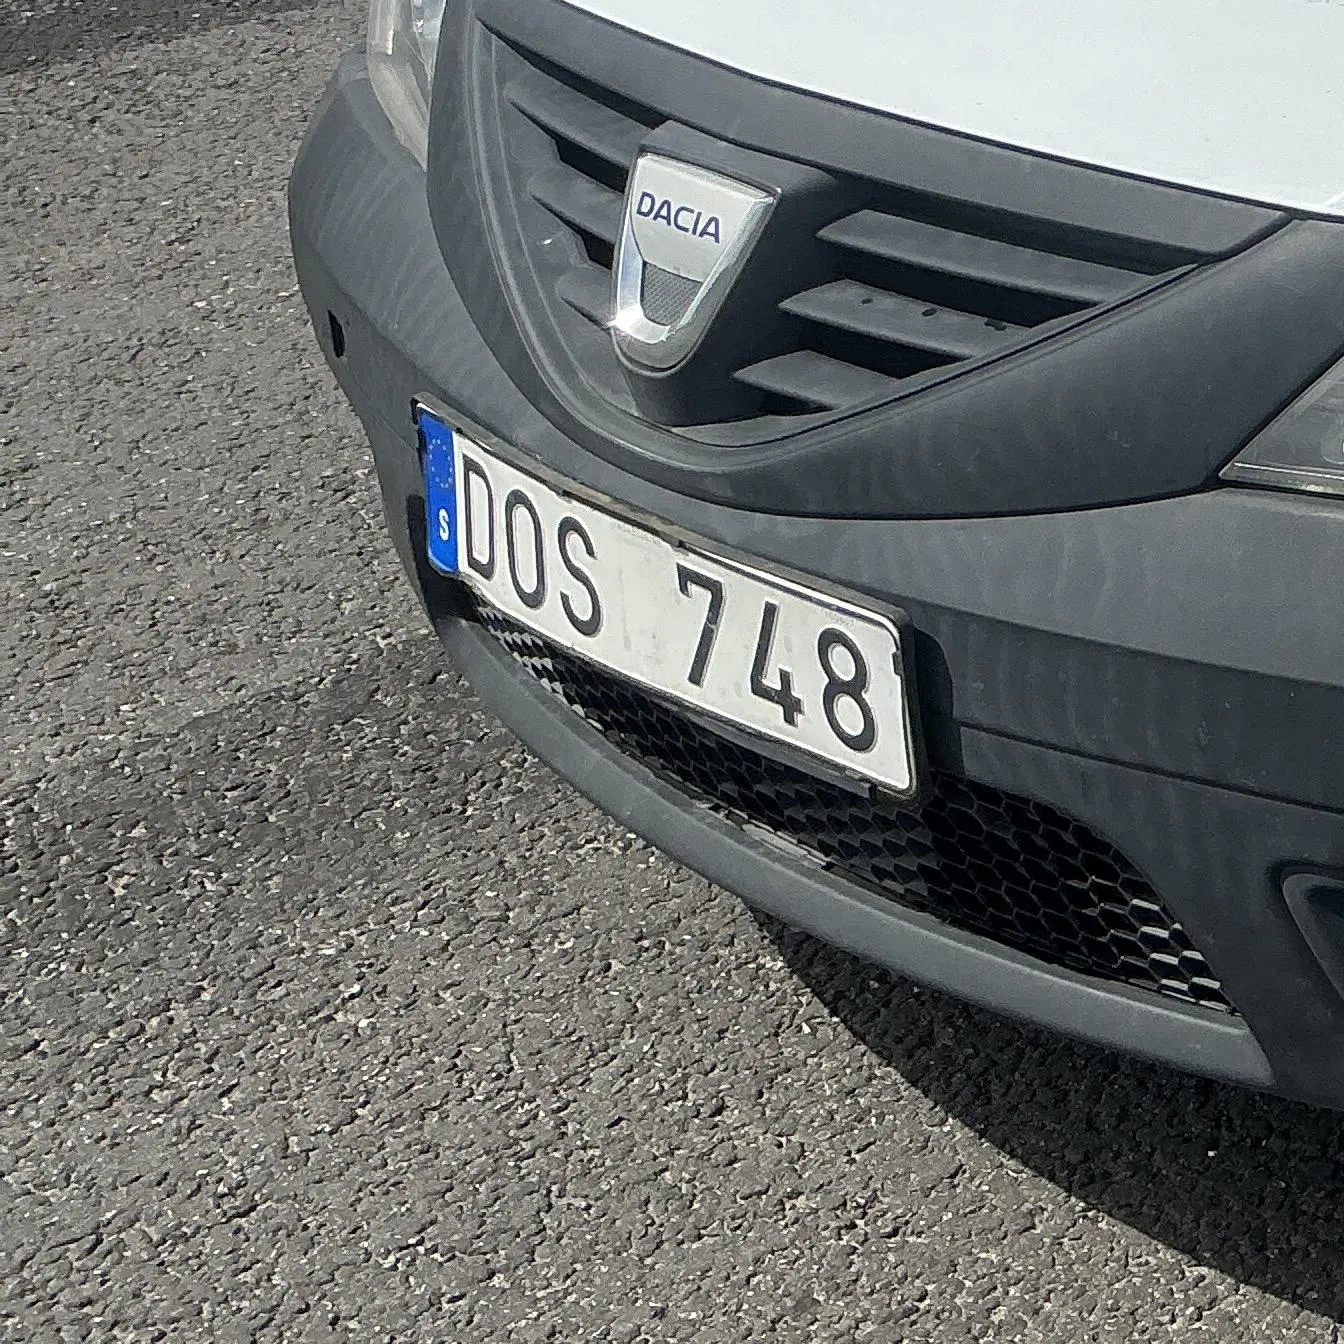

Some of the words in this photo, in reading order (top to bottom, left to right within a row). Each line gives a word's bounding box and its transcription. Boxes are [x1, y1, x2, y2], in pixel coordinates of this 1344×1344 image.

[634, 190, 722, 245] DACIA
[437, 508, 450, 542] S
[463, 452, 603, 639] DOS
[677, 560, 878, 754] 748
